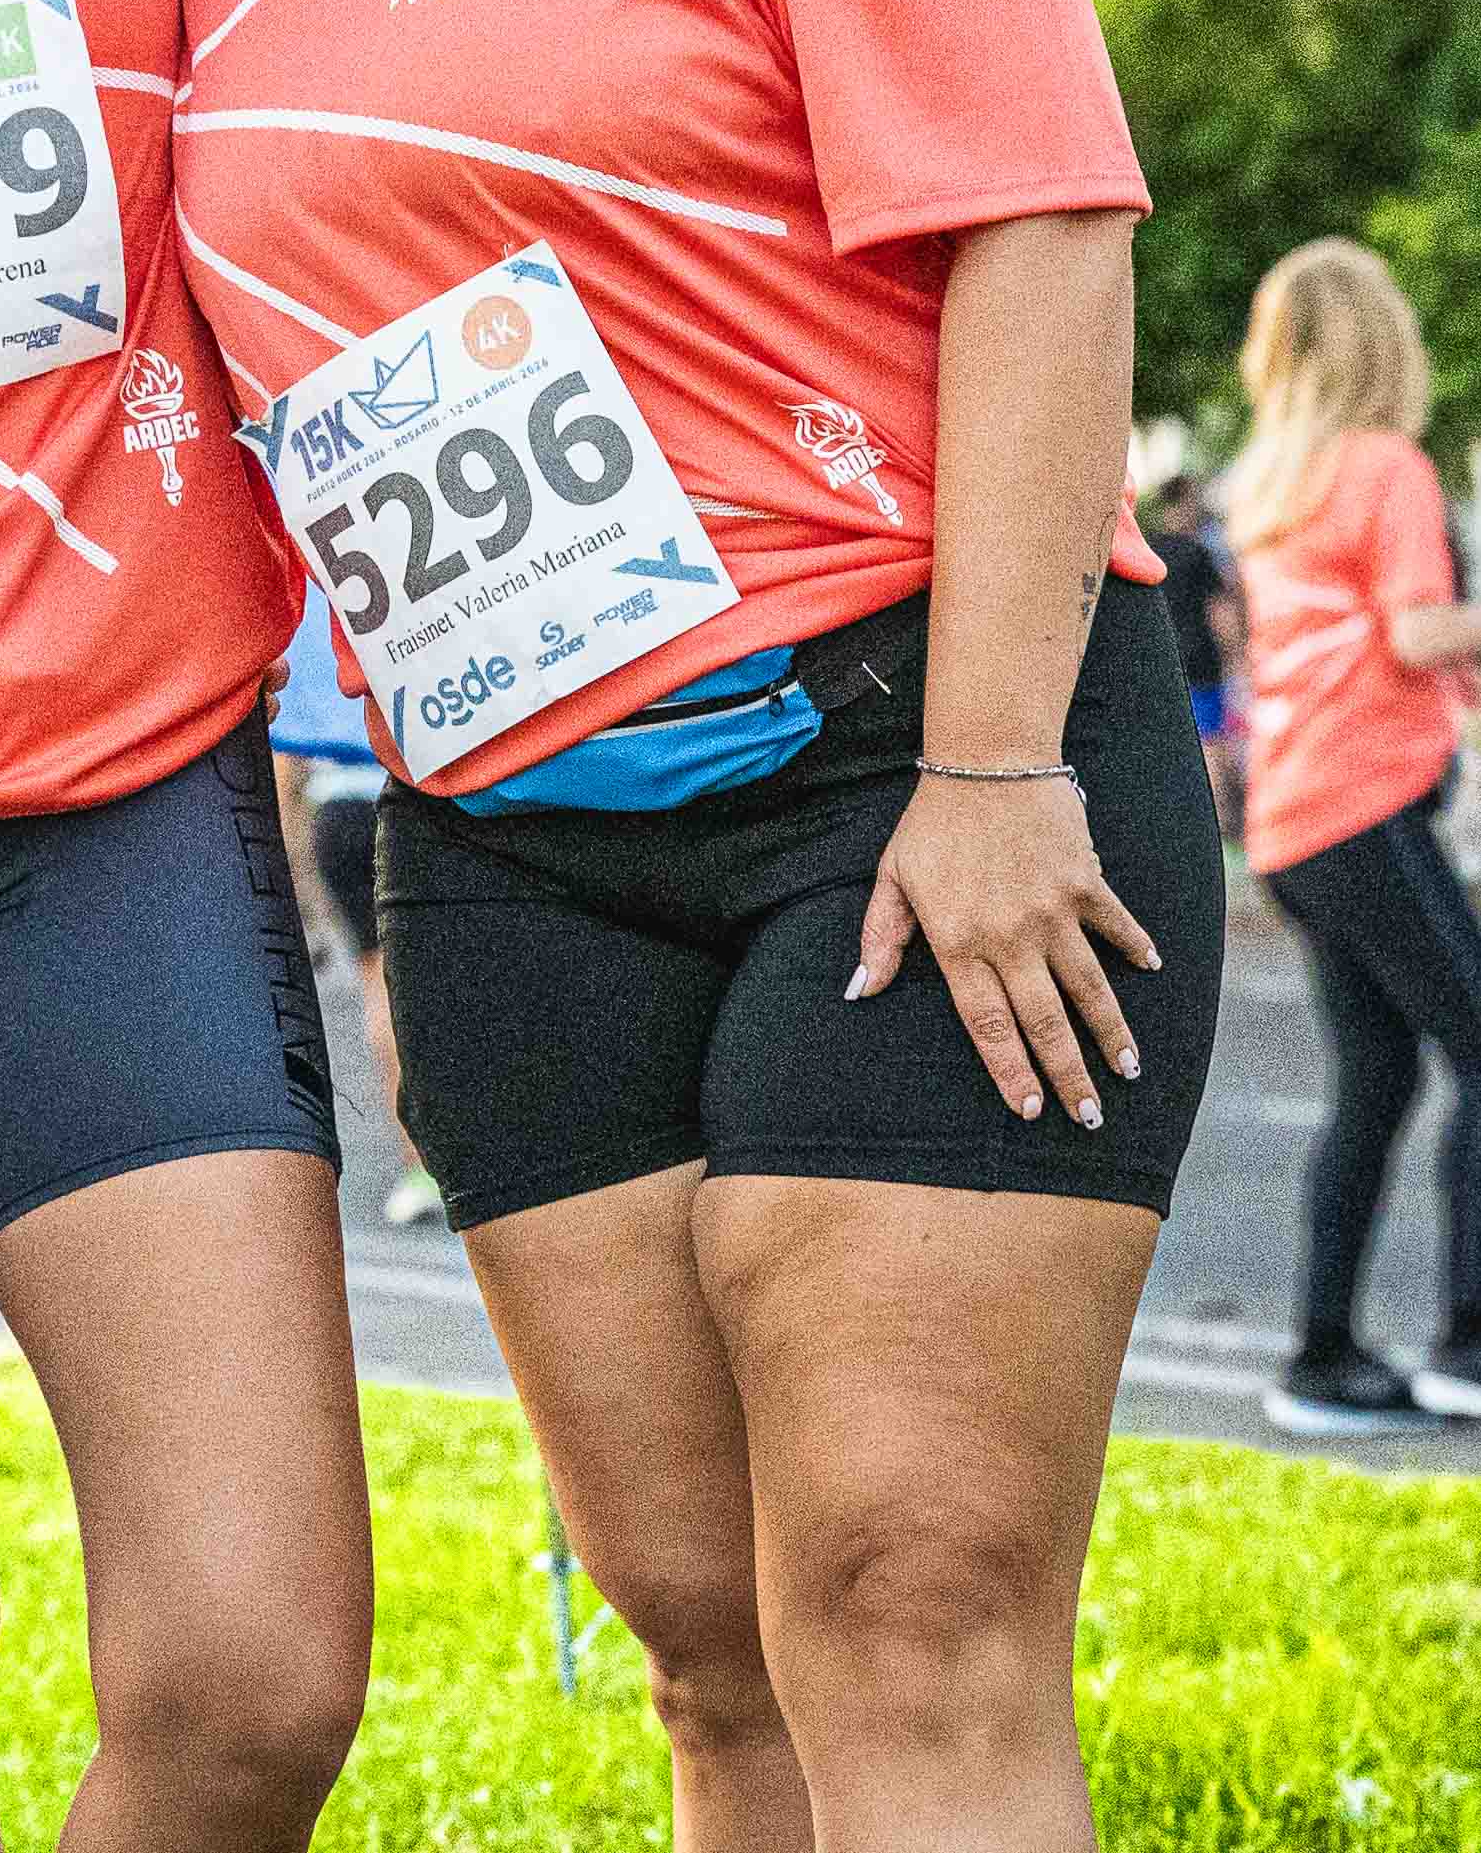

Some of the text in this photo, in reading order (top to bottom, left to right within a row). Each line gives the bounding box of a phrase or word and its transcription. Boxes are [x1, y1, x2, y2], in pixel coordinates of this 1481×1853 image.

[1, 324, 62, 348] POWER
[477, 310, 524, 348] 4K
[123, 411, 200, 453] ARDEC
[393, 418, 439, 448] ROSARIO
[450, 404, 465, 419] 12
[466, 393, 482, 409] DE
[483, 375, 517, 400] ABRIL
[520, 356, 549, 379] 2026
[290, 399, 364, 481] 15K
[305, 370, 634, 635] 5296
[384, 519, 628, 665] Fraisinet Valeria Mariana
[592, 588, 654, 627] POWER
[420, 655, 517, 729] osde
